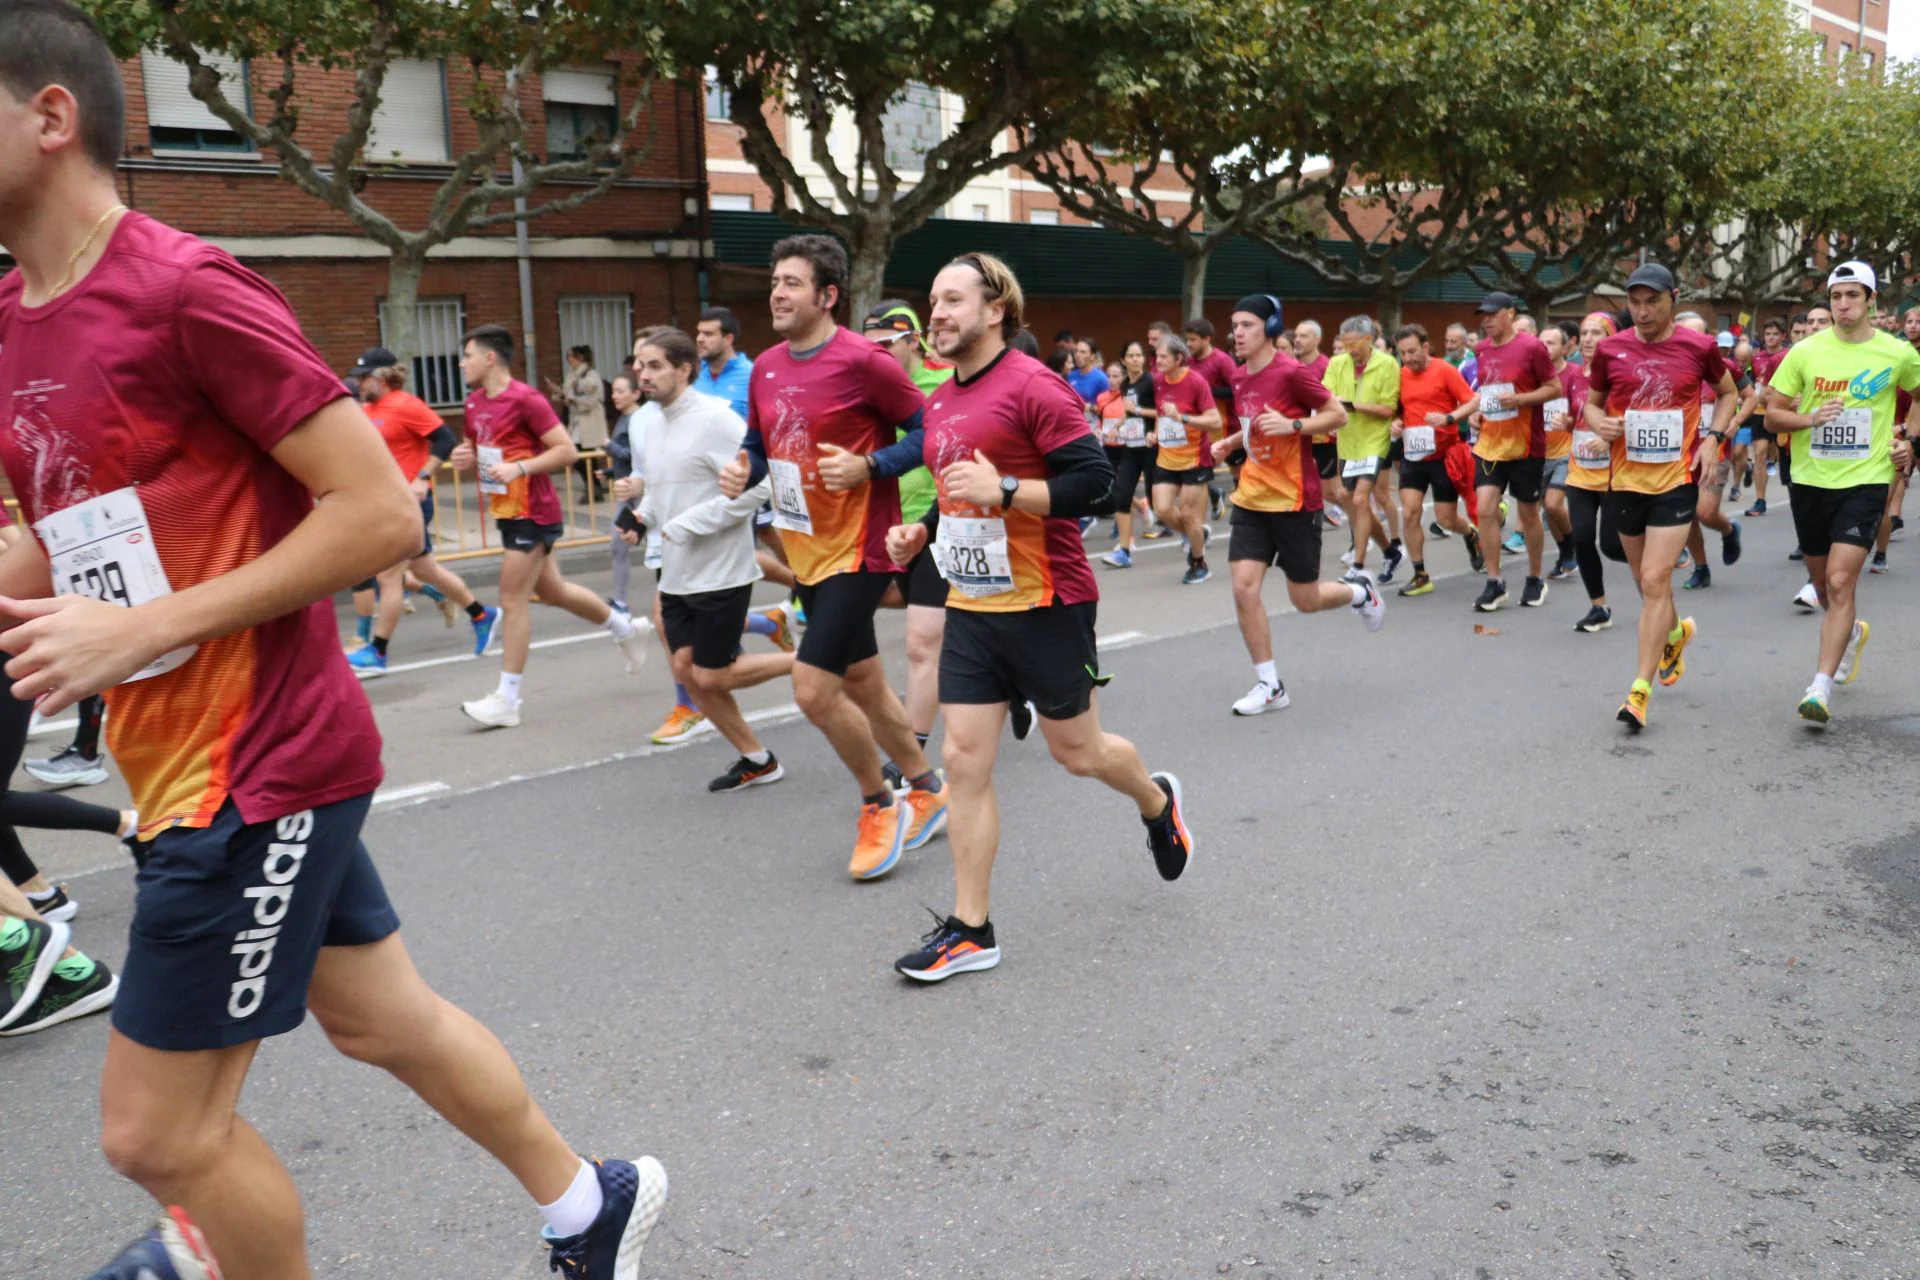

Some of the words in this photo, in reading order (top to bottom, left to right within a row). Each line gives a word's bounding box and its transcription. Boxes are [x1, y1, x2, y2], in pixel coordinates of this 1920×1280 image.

[1813, 376, 1849, 392] Run
[1851, 383, 1871, 398] 04
[1637, 429, 1669, 447] 656
[1823, 426, 1856, 444] 699
[948, 545, 990, 576] 328
[227, 808, 315, 1019] adidas
